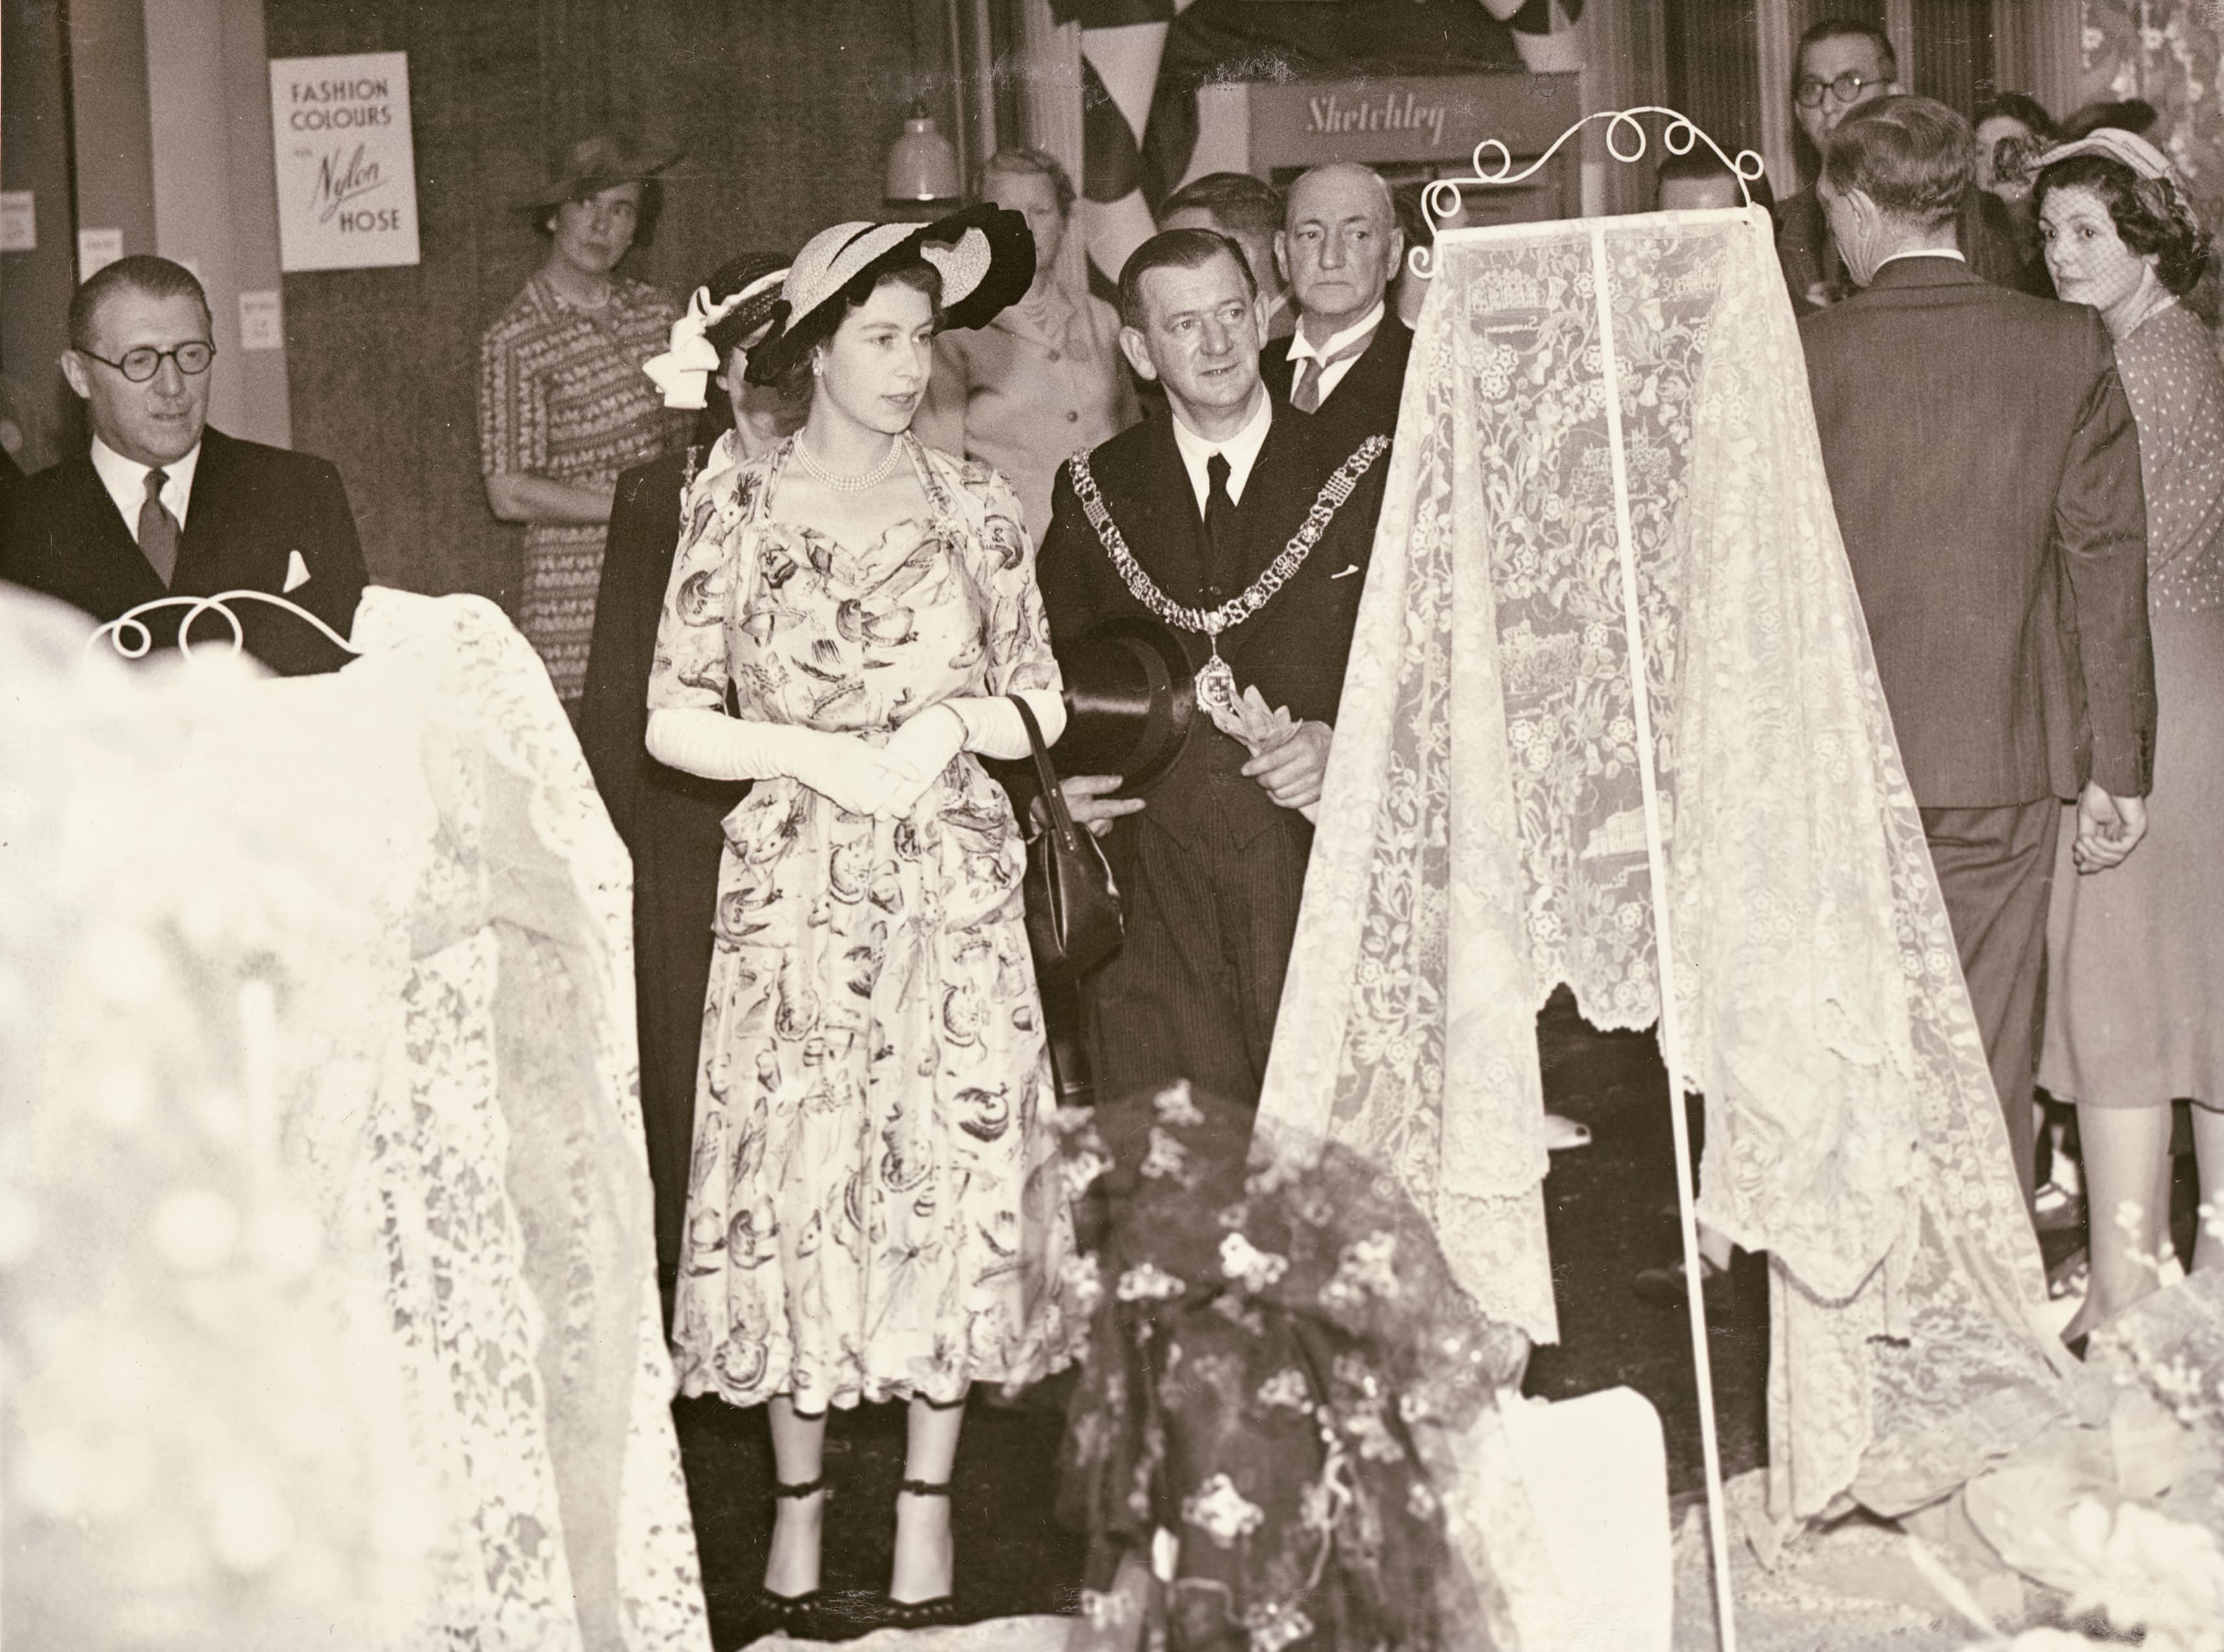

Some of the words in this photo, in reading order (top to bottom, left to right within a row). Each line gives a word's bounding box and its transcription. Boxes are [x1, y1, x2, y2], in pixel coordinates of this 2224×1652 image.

[292, 79, 388, 103] FASHION
[291, 106, 392, 130] COLOURS
[308, 143, 388, 224] Nylon
[340, 208, 400, 232] HOSE
